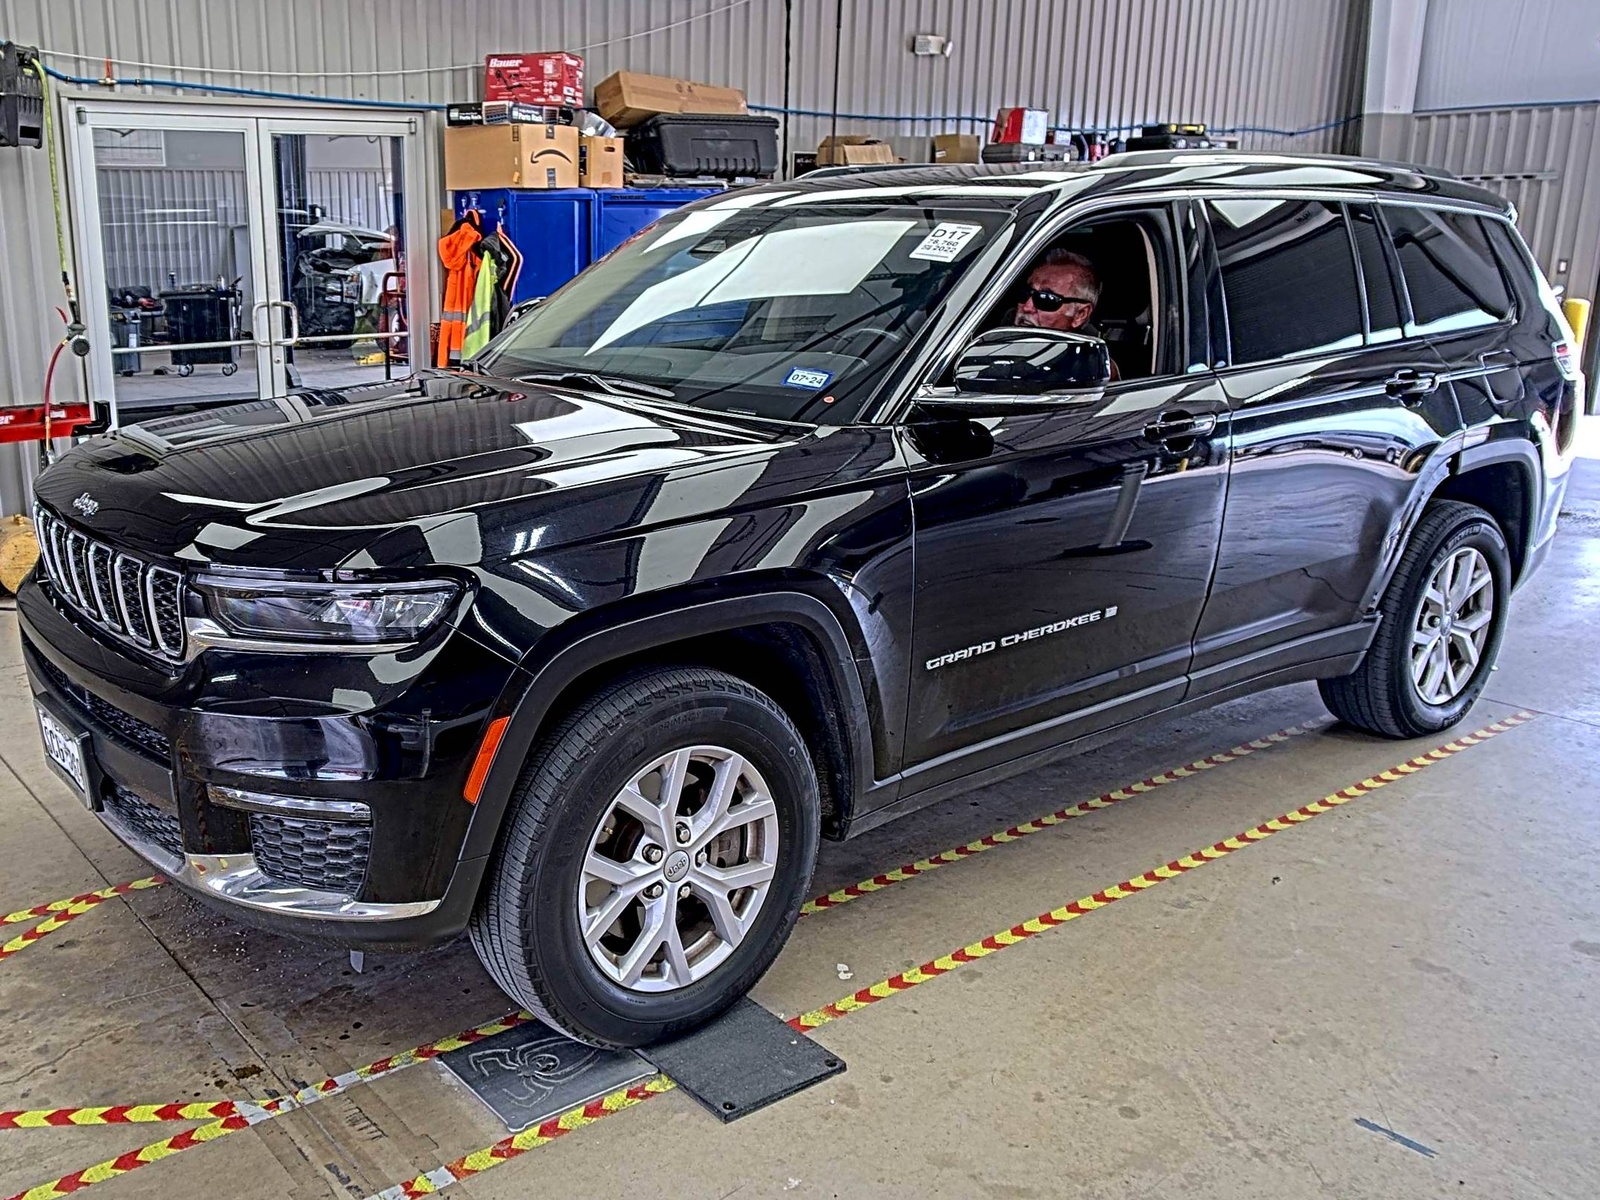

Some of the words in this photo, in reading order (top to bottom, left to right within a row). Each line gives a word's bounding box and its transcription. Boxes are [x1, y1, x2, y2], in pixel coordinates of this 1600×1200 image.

[489, 58, 523, 68] Bauer
[931, 229, 970, 240] D17
[925, 640, 996, 671] GRAND
[1000, 610, 1102, 648] CHEROKEE
[667, 856, 687, 877] Jeep
